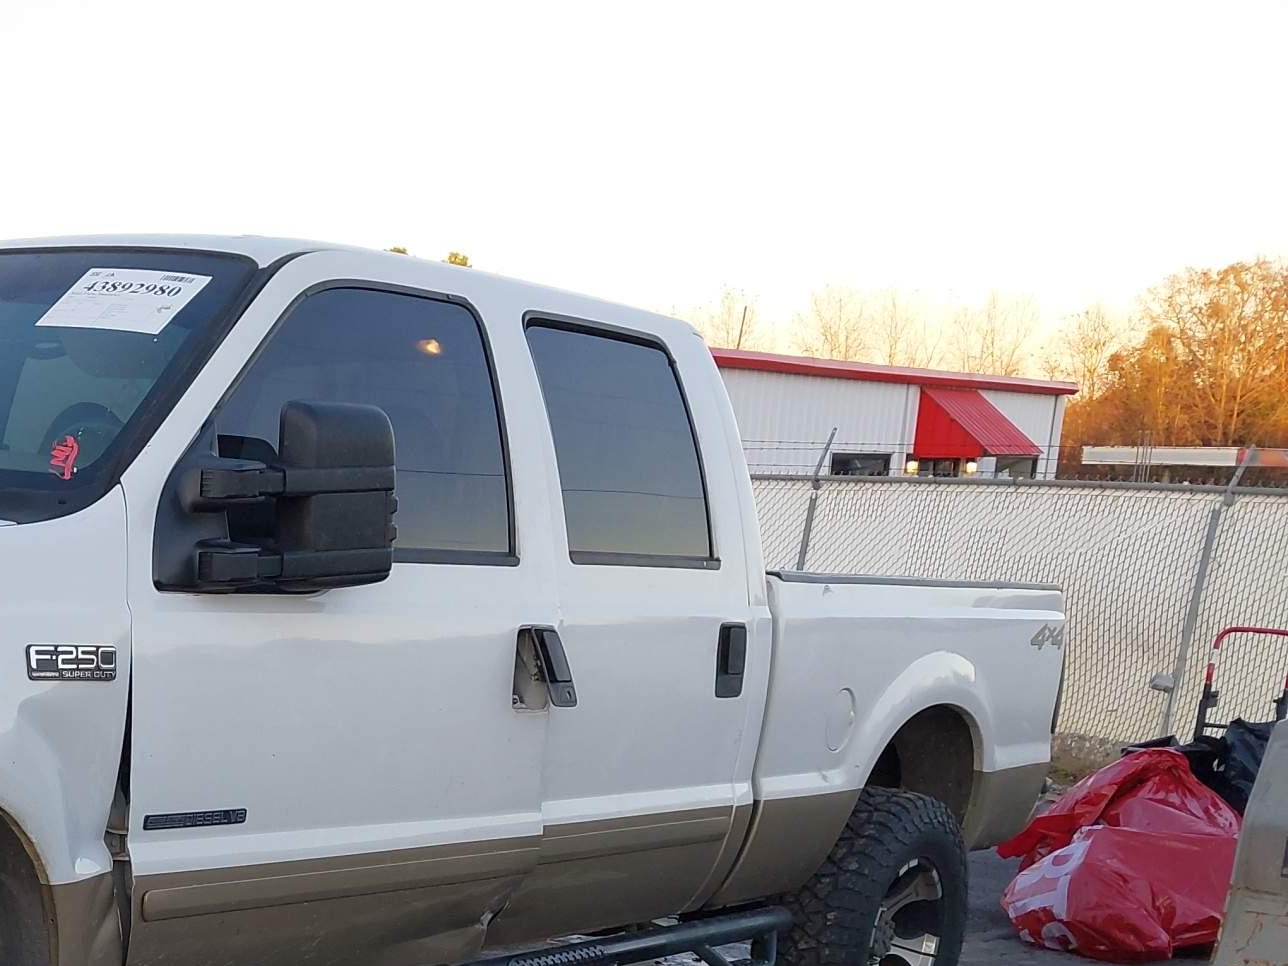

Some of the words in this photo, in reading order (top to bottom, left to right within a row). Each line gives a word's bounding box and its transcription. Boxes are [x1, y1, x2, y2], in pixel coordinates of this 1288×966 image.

[83, 281, 182, 296] 43892980
[29, 645, 116, 669] F-250
[62, 670, 91, 679] SUPER
[93, 670, 116, 679] DUTY
